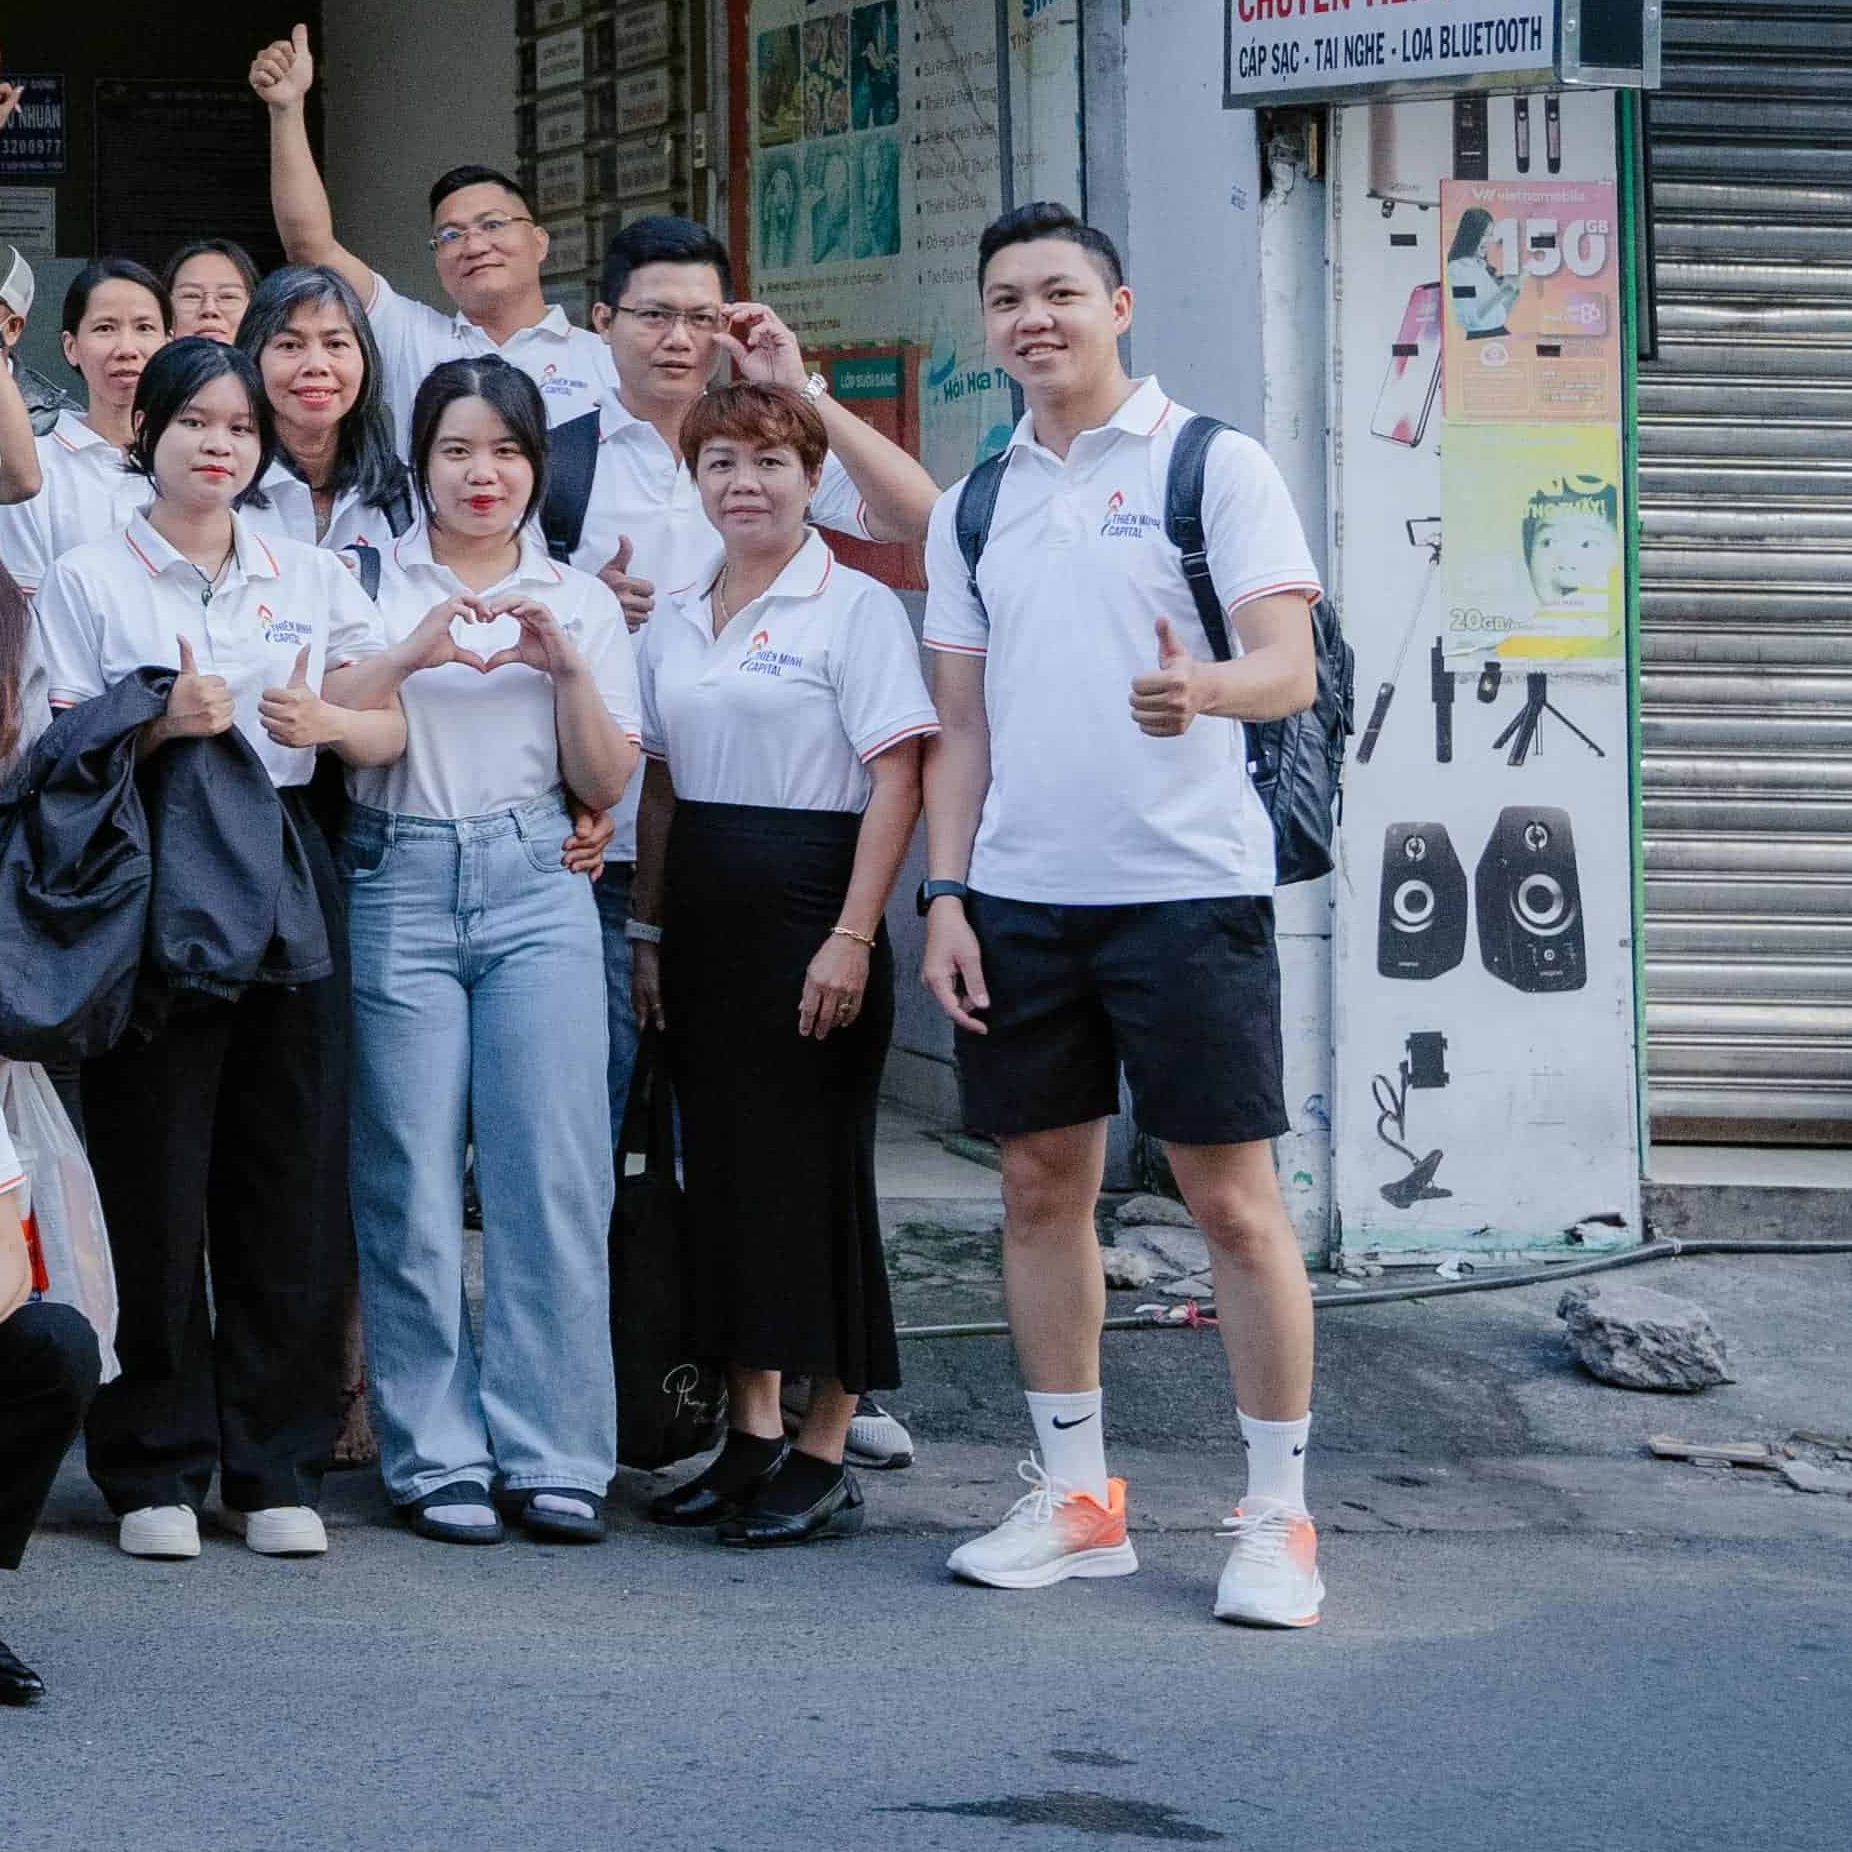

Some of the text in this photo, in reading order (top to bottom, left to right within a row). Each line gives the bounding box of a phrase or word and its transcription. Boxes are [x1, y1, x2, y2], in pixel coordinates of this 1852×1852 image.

[1238, 15, 1543, 82] CÁP SẠC TAI NGHE LOA BLUETOOTH
[1486, 218, 1608, 279] 150
